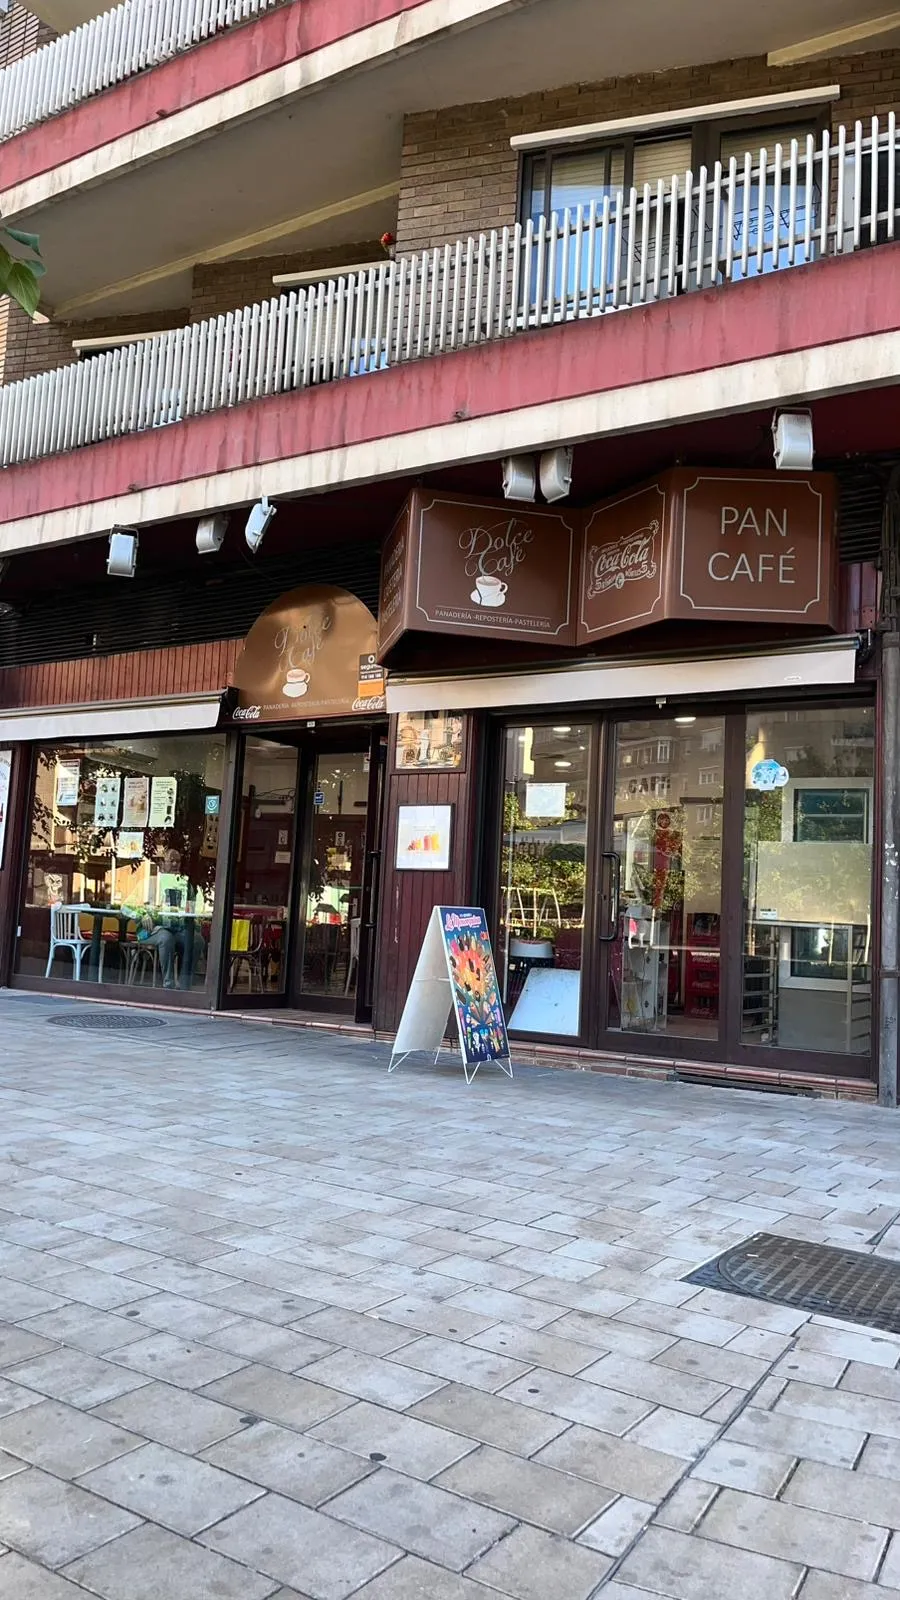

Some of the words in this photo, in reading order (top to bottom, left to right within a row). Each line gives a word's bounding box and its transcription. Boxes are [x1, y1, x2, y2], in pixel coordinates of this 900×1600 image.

[720, 506, 787, 537] PAN
[459, 518, 534, 559] Dolce
[465, 541, 526, 577] Café
[594, 535, 652, 578] Coca-Cola
[708, 546, 796, 584] CAFÉ
[435, 609, 472, 620] PANADERÍA
[233, 705, 262, 719] Coca-Cola
[352, 696, 385, 711] Coca-Cola
